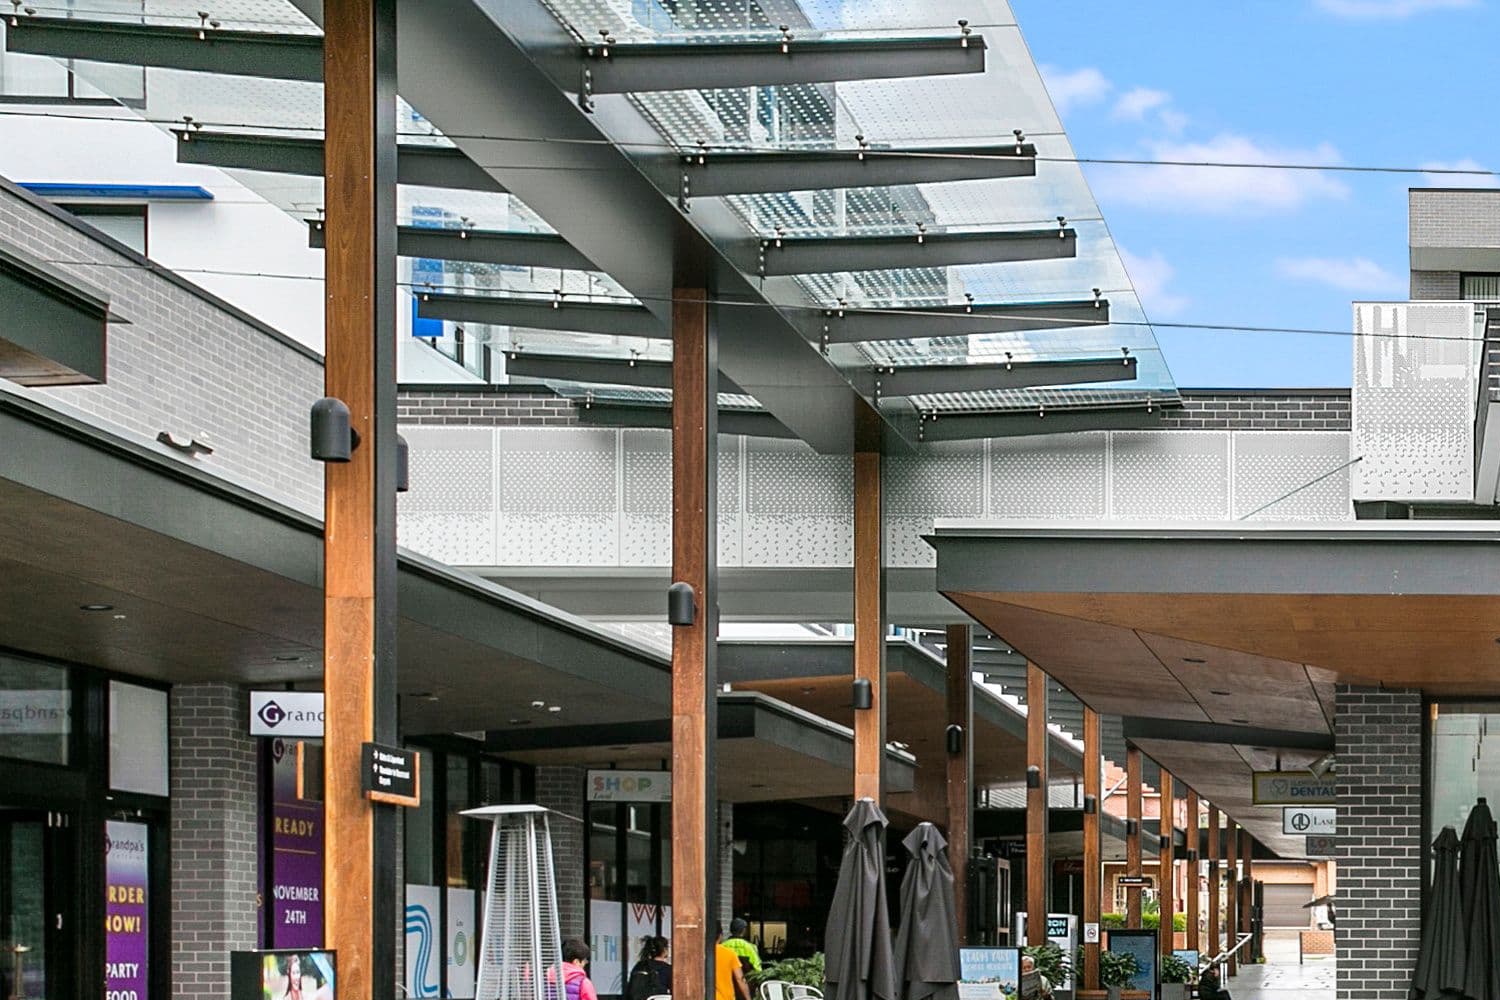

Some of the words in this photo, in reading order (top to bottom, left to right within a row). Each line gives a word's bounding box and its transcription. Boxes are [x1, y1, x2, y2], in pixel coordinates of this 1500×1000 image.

[593, 776, 652, 793] SHOP
[274, 817, 315, 837] READY
[108, 885, 145, 904] RDER
[284, 909, 307, 925] 24TH
[105, 963, 139, 979] PARTY
